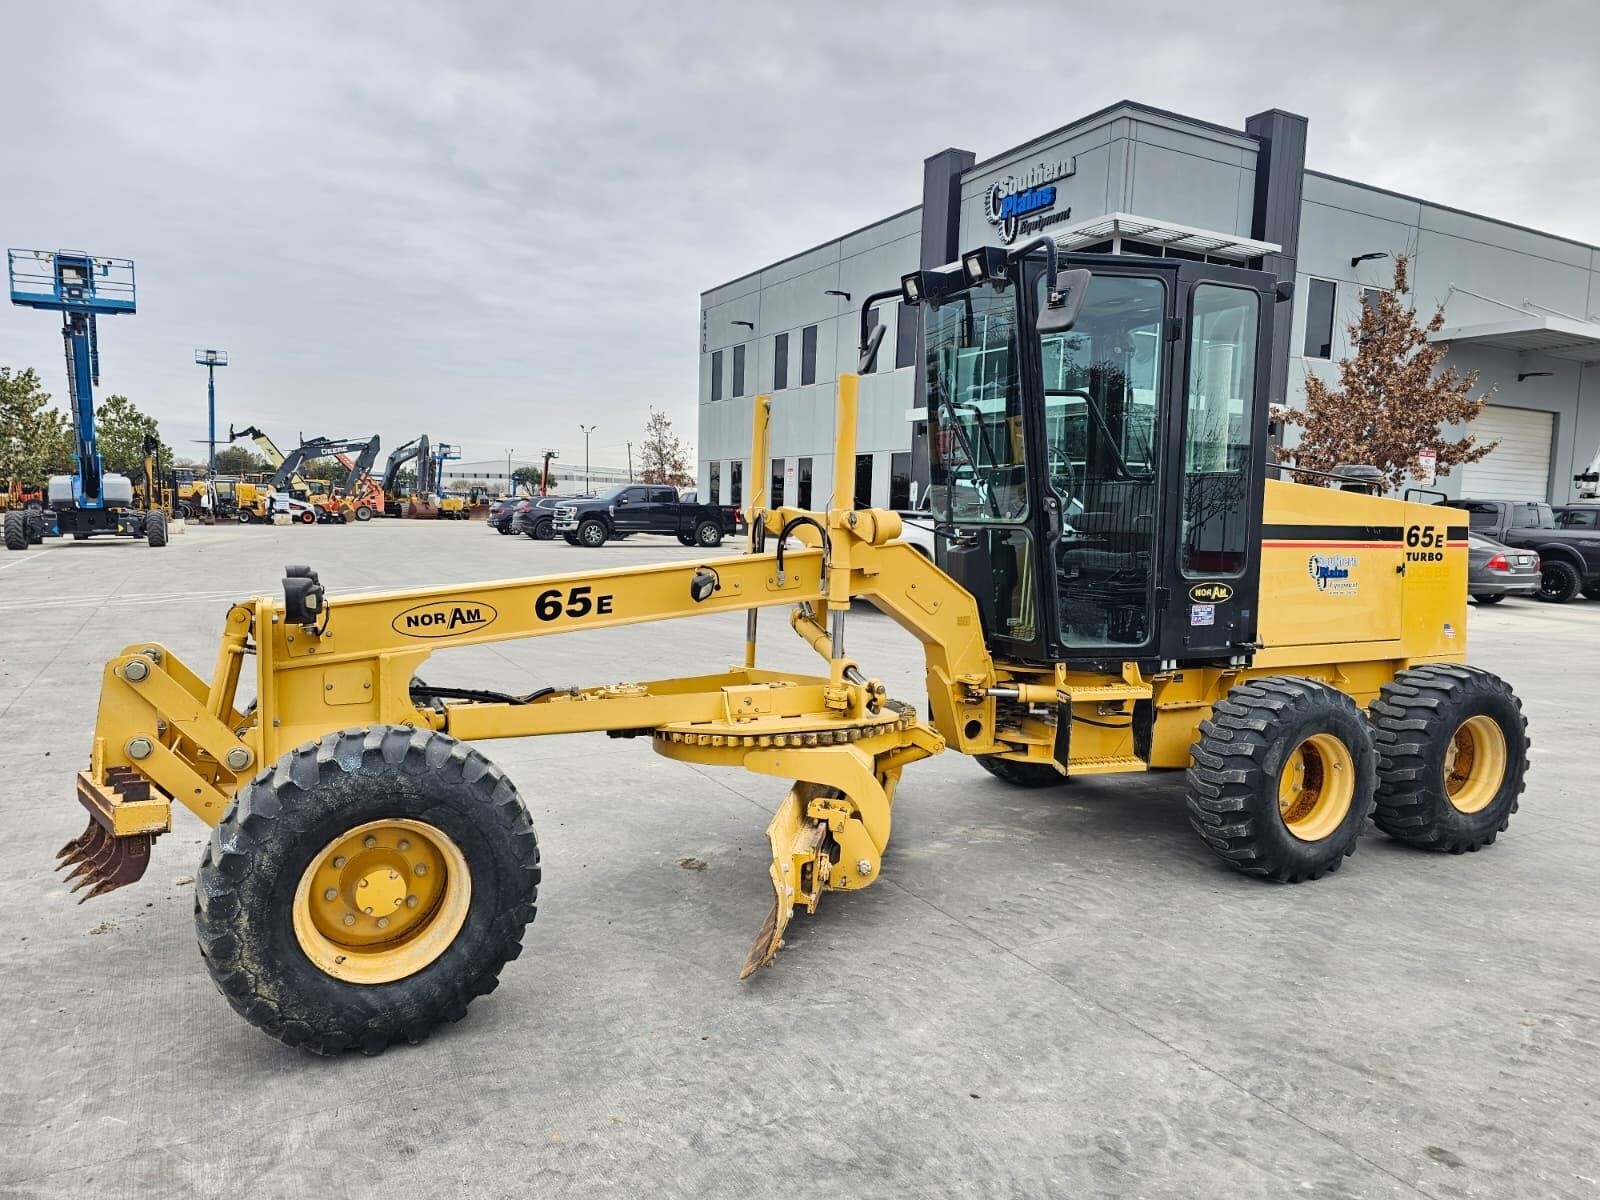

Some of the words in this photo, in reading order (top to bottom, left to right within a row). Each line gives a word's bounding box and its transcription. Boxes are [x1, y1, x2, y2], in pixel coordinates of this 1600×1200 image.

[998, 158, 1076, 199] Southern
[1002, 187, 1056, 220] Plains
[1019, 207, 1071, 235] Equipment
[321, 446, 348, 455] DEERE
[1406, 552, 1443, 562] TURBO
